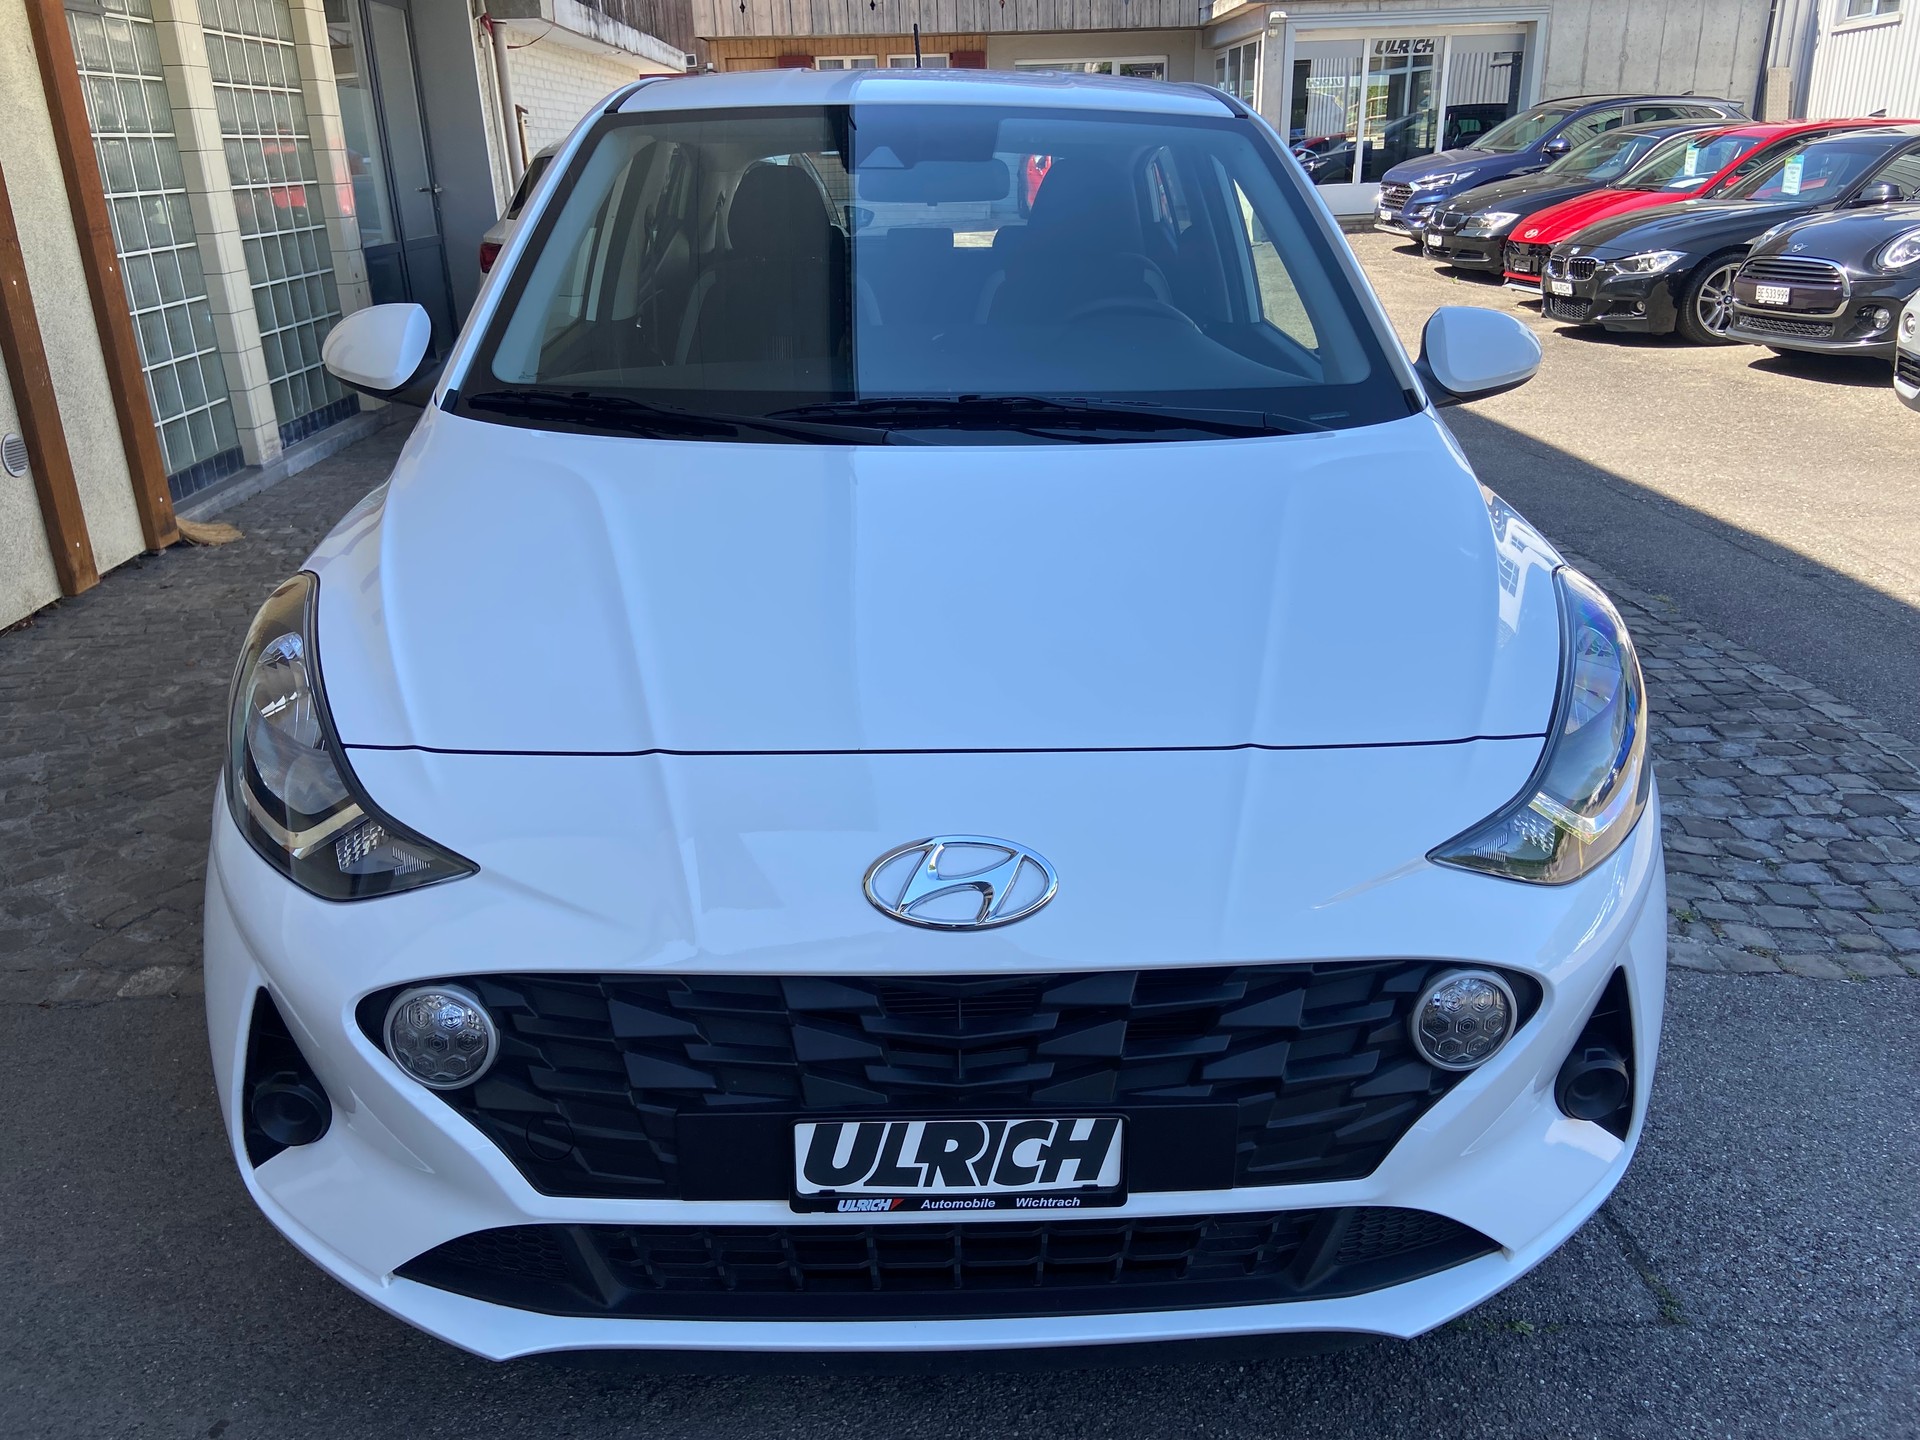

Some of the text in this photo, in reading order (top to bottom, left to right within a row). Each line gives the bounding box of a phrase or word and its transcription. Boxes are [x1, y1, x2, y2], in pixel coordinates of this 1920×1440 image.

[1375, 39, 1434, 54] ULRICH
[804, 1119, 1119, 1187] ULRICH
[837, 1197, 1080, 1211] ULRICH Automobile Wichtrach
